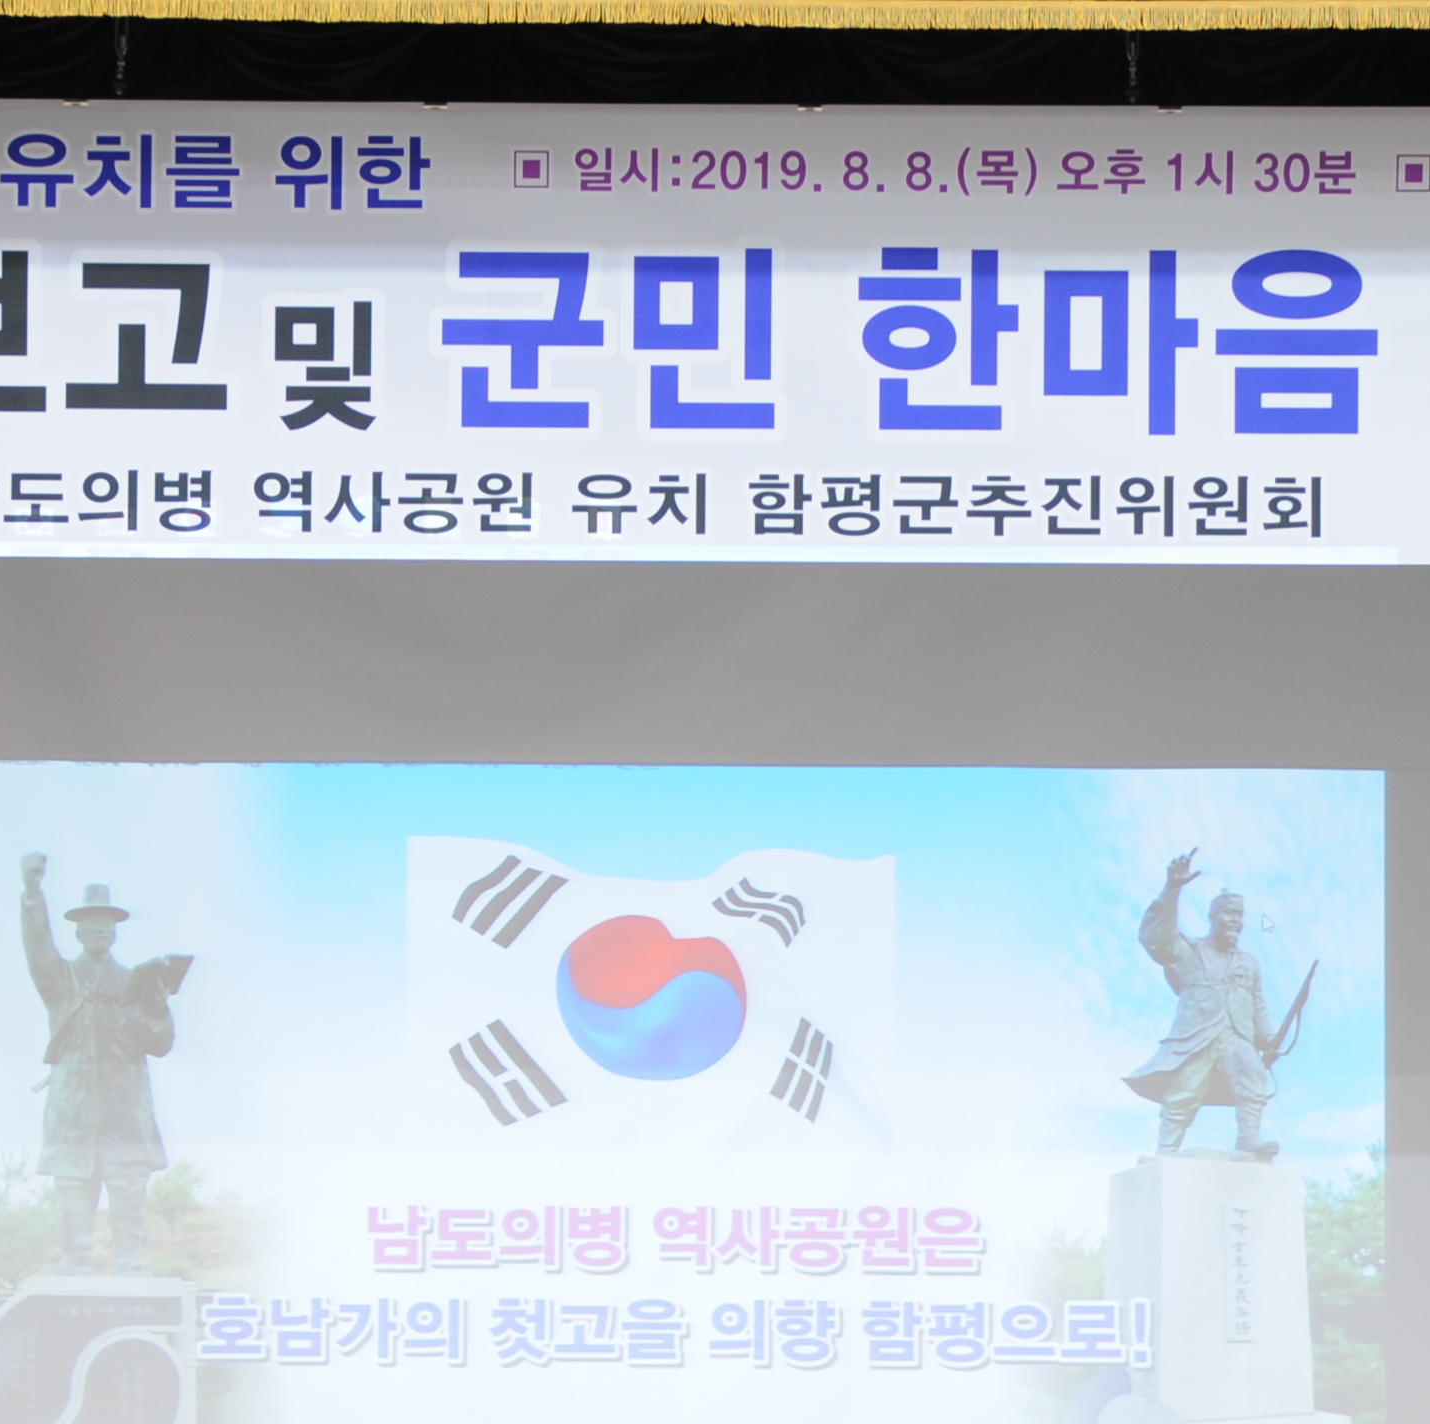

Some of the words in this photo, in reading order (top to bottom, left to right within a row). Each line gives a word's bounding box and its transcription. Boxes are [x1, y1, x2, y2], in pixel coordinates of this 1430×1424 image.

[276, 136, 430, 209] 위한
[575, 148, 821, 191] 일시:2019.
[843, 151, 884, 192] 8.
[906, 147, 1036, 195] 8.(목)
[1057, 149, 1145, 193] 오후
[1168, 151, 1233, 194] 1시
[1255, 151, 1356, 193] 30분
[275, 301, 376, 430] 및
[442, 247, 774, 429] 군민
[859, 246, 1378, 435] 한마음
[254, 471, 532, 533] 역사공원
[572, 473, 706, 534] 유치
[749, 474, 1321, 537] 함평군추진위원회
[367, 1204, 628, 1271] 남도의병
[653, 1205, 982, 1271] 역사공원은
[198, 1295, 464, 1362] 호남가의
[488, 1298, 684, 1362] 첫고을
[708, 1299, 837, 1364] 의향
[861, 1299, 1148, 1365] 함평으로!
